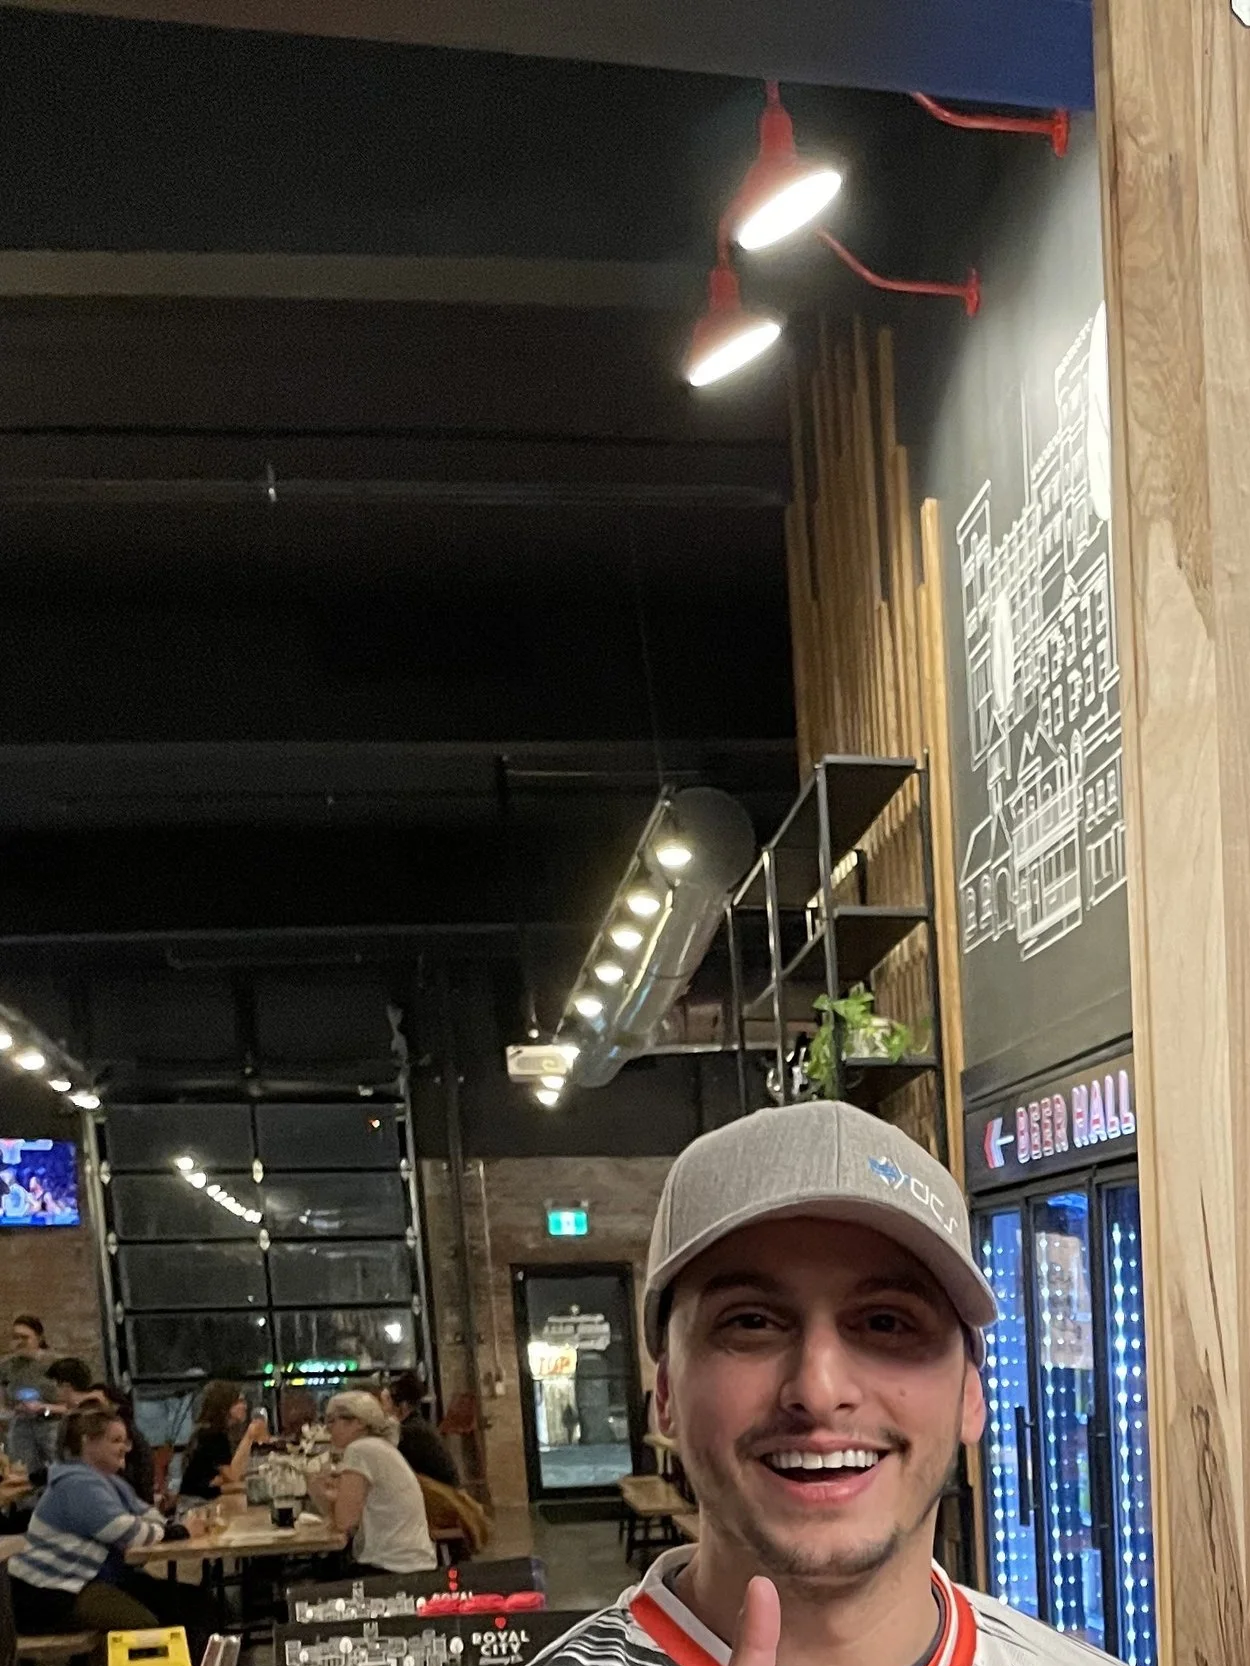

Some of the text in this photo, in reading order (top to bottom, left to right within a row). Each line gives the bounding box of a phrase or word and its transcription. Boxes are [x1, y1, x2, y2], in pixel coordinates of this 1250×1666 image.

[1071, 1069, 1136, 1149] HALL
[472, 1629, 530, 1645] ROYAL
[480, 1640, 522, 1657] CITY
